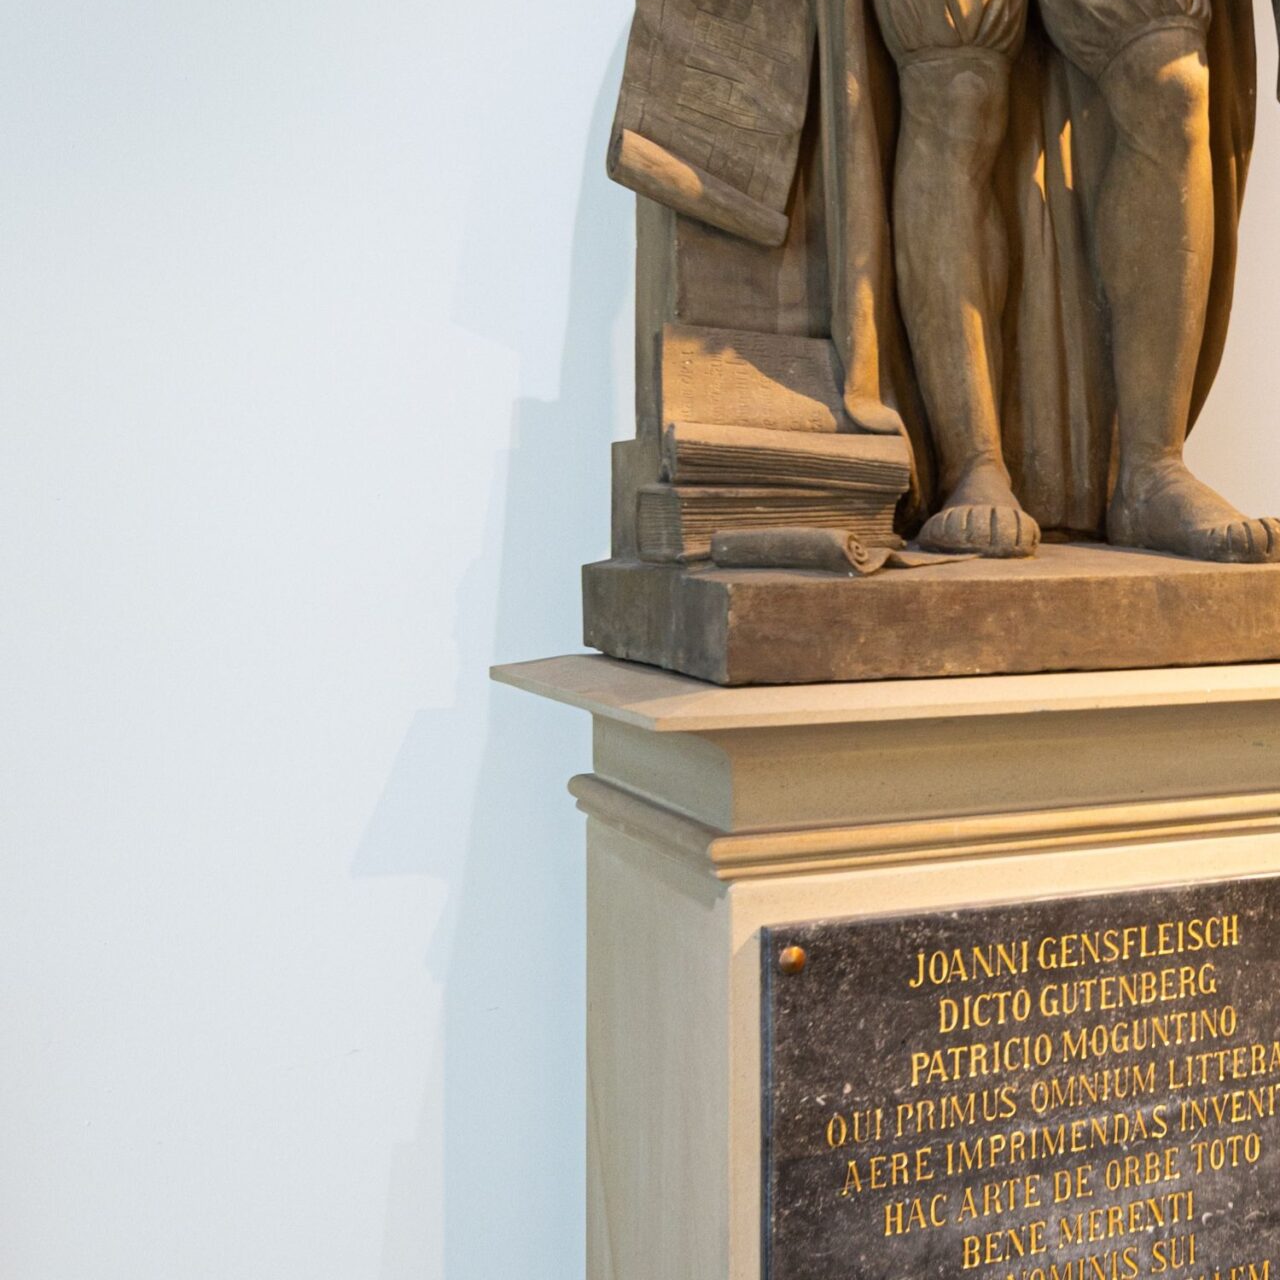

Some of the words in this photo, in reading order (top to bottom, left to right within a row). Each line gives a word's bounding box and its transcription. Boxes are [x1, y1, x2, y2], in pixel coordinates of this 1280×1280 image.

[909, 940, 1029, 988] JOANNI
[1037, 914, 1239, 970] GENSFLEISCH
[939, 987, 1031, 1034] DICTO
[1039, 962, 1217, 1017] GUTENBERG
[911, 1033, 1053, 1087] PATRICIO
[1062, 1005, 1238, 1061] MOGUNTINO
[897, 1085, 1017, 1136] PRIMUS
[1031, 1061, 1156, 1113] OMNIUM
[841, 1147, 934, 1196] AERE
[946, 1105, 1168, 1175] IMPRIMENDAS
[884, 1194, 947, 1237] HAC
[958, 1174, 1041, 1222] ARTE
[1053, 1164, 1093, 1204] DE
[1105, 1147, 1181, 1191] ORBE
[1190, 1133, 1261, 1174] TOTO
[962, 1221, 1047, 1269] BENE
[1059, 1190, 1194, 1249] MERENTI
[1151, 1232, 1196, 1273] SUI
